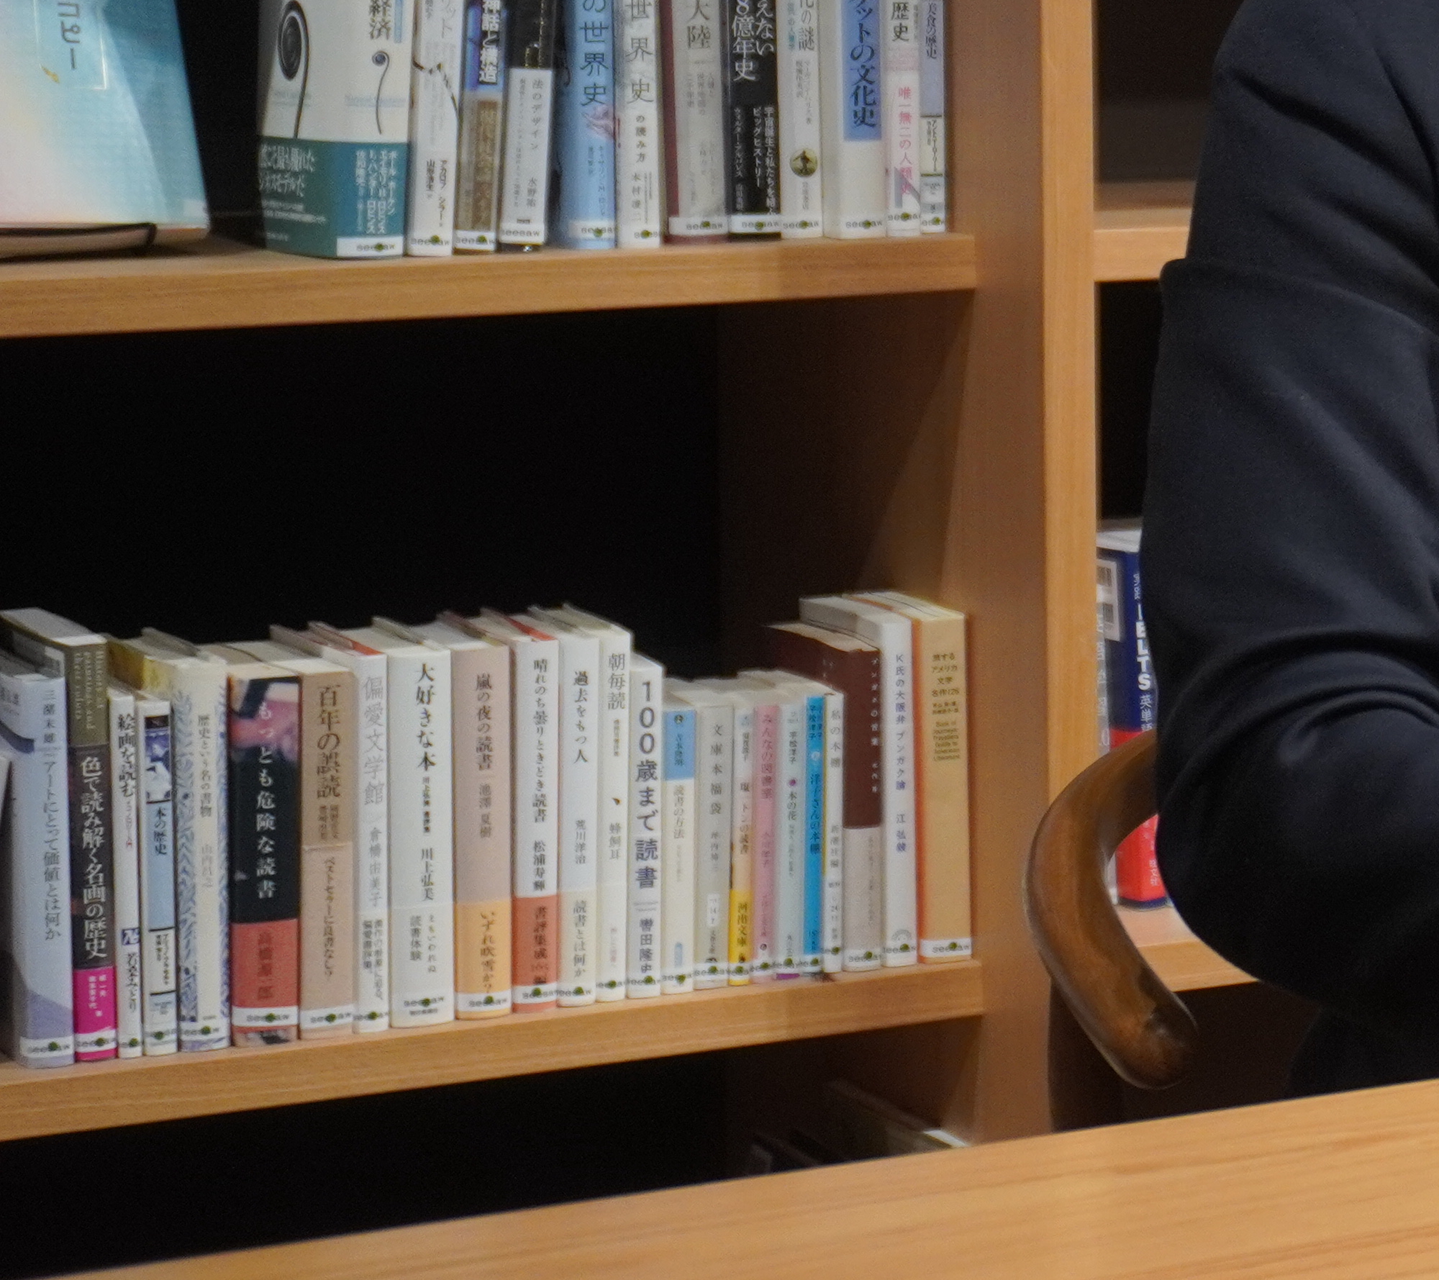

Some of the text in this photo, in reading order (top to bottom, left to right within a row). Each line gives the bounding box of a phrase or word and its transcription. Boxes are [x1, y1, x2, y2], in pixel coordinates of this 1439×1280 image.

[529, 79, 545, 152] 法のデザイン
[898, 87, 913, 195] 唯一無二の人類史
[415, 663, 435, 771] 大好きな本
[607, 653, 626, 710] 朝毎読
[895, 654, 907, 791] K氏の大阪弁ブンガク論
[118, 714, 137, 797] 絵画を読む
[317, 684, 342, 799] 百年の誤読
[363, 676, 385, 806] 偏愛文学館
[475, 674, 493, 838] 嵐の夜の読書 池澤夏樹
[532, 659, 548, 892] 晴れのち曇りときどき読書 松浦寿輝
[573, 671, 590, 864] 過去をもつ人 荒川洋治
[635, 681, 659, 889] 100歳まで読書
[710, 724, 723, 815] 文庫本福袋
[761, 714, 773, 799] みんなの図書室
[43, 761, 61, 941] アートにとって価値とは何か
[154, 807, 168, 855] 本の歴史
[256, 702, 277, 899] もっとも危険な読書
[81, 756, 107, 960] 色で読み解く名画の歴史
[369, 827, 383, 907] 倉橋由美子
[421, 847, 434, 901] 川上弘美
[410, 916, 422, 961] 読書体験
[573, 900, 587, 978] 読書とは何か
